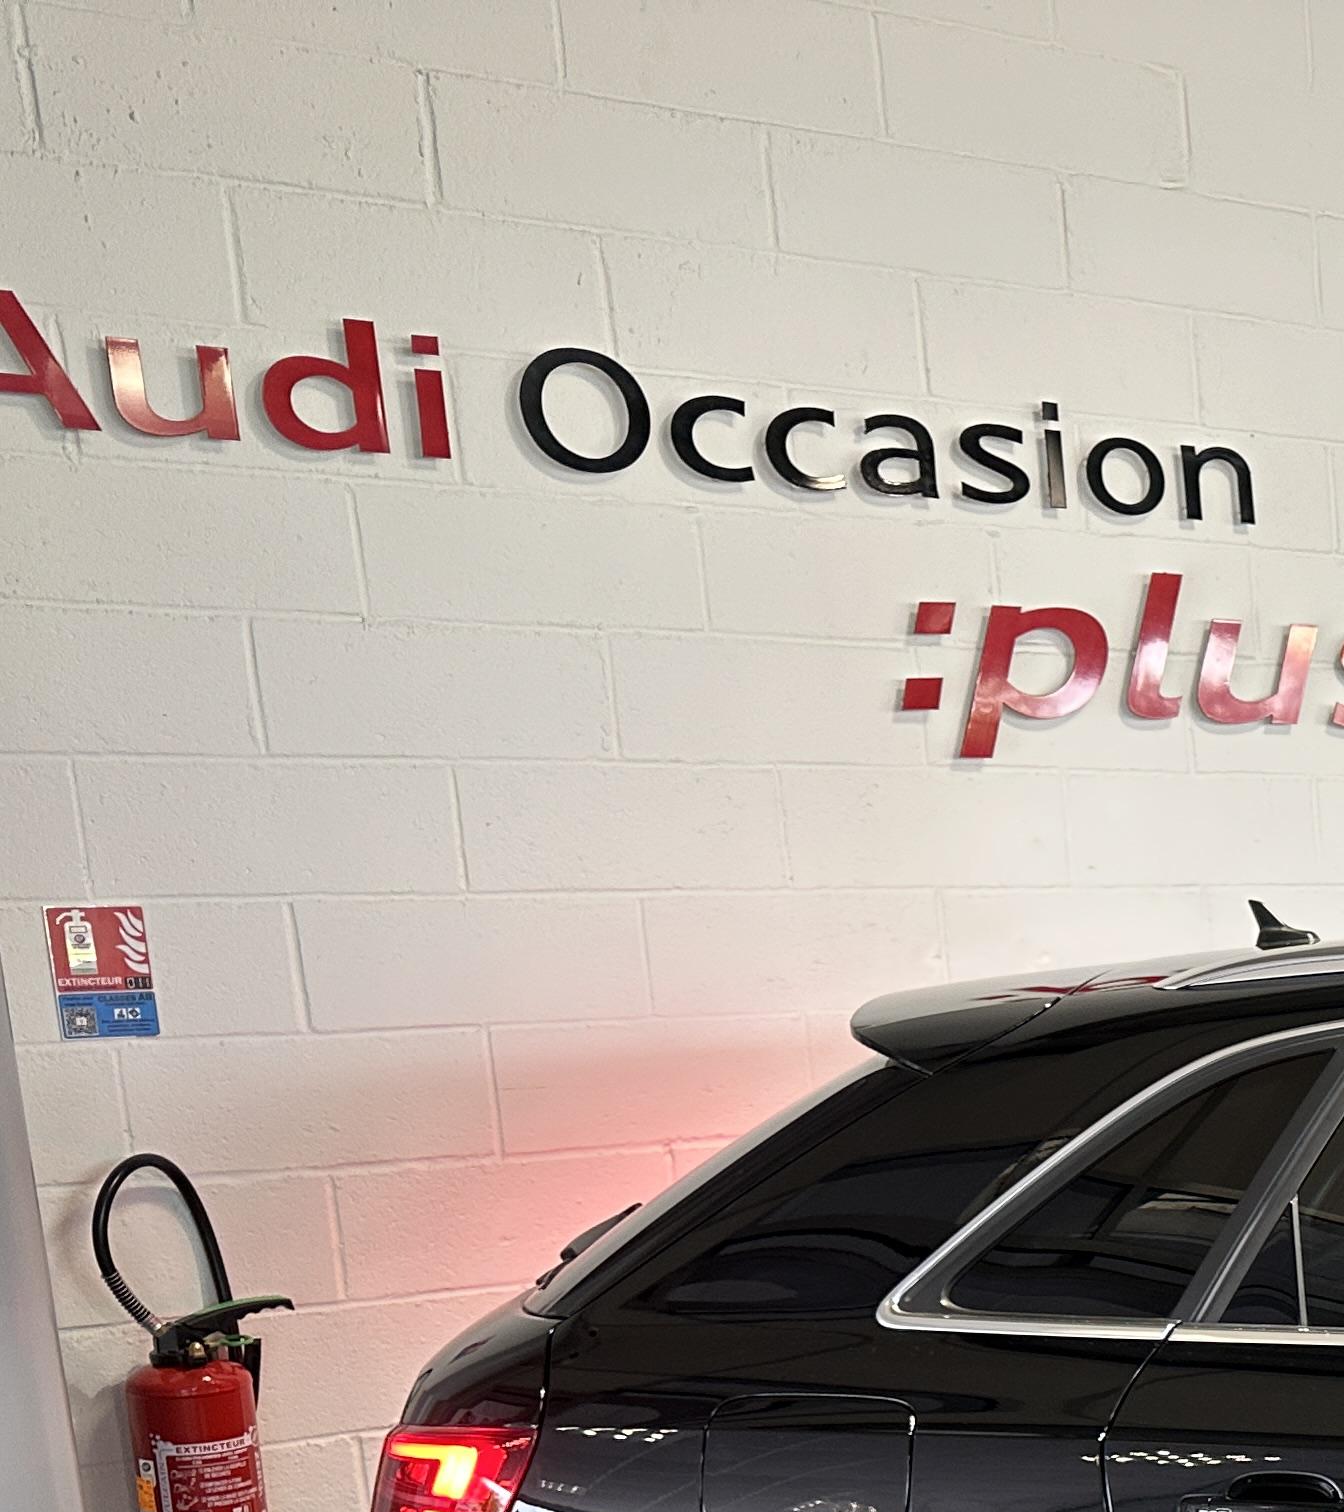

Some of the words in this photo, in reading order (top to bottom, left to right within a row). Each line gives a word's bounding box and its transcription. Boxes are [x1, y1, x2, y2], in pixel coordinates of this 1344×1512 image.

[519, 347, 1255, 524] Occasion
[58, 977, 122, 987] EXTINCTEUR
[176, 1438, 246, 1454] EXTINCTEUR
